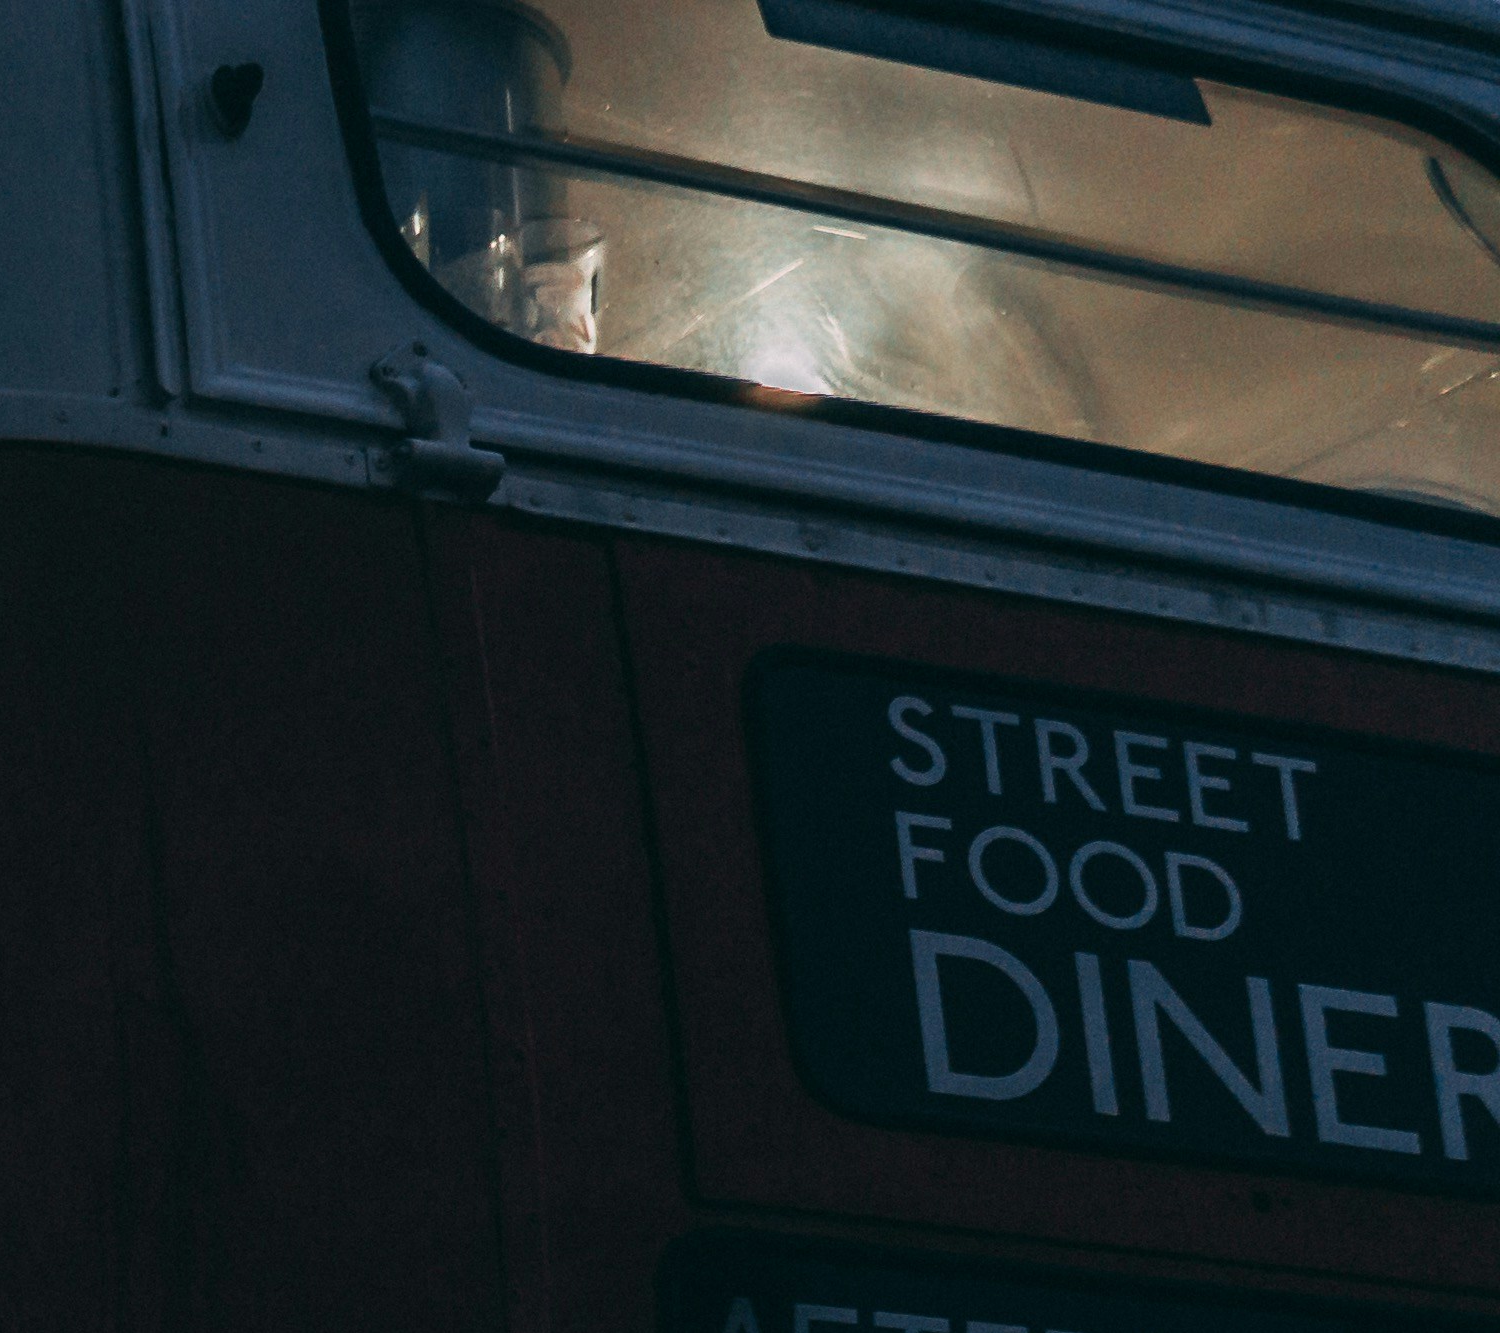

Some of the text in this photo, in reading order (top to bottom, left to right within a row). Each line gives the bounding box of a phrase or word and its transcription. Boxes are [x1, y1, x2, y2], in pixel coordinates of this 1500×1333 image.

[887, 695, 1317, 841] STREET
[895, 811, 1243, 942] FOOD
[909, 929, 1500, 1161] DINER
